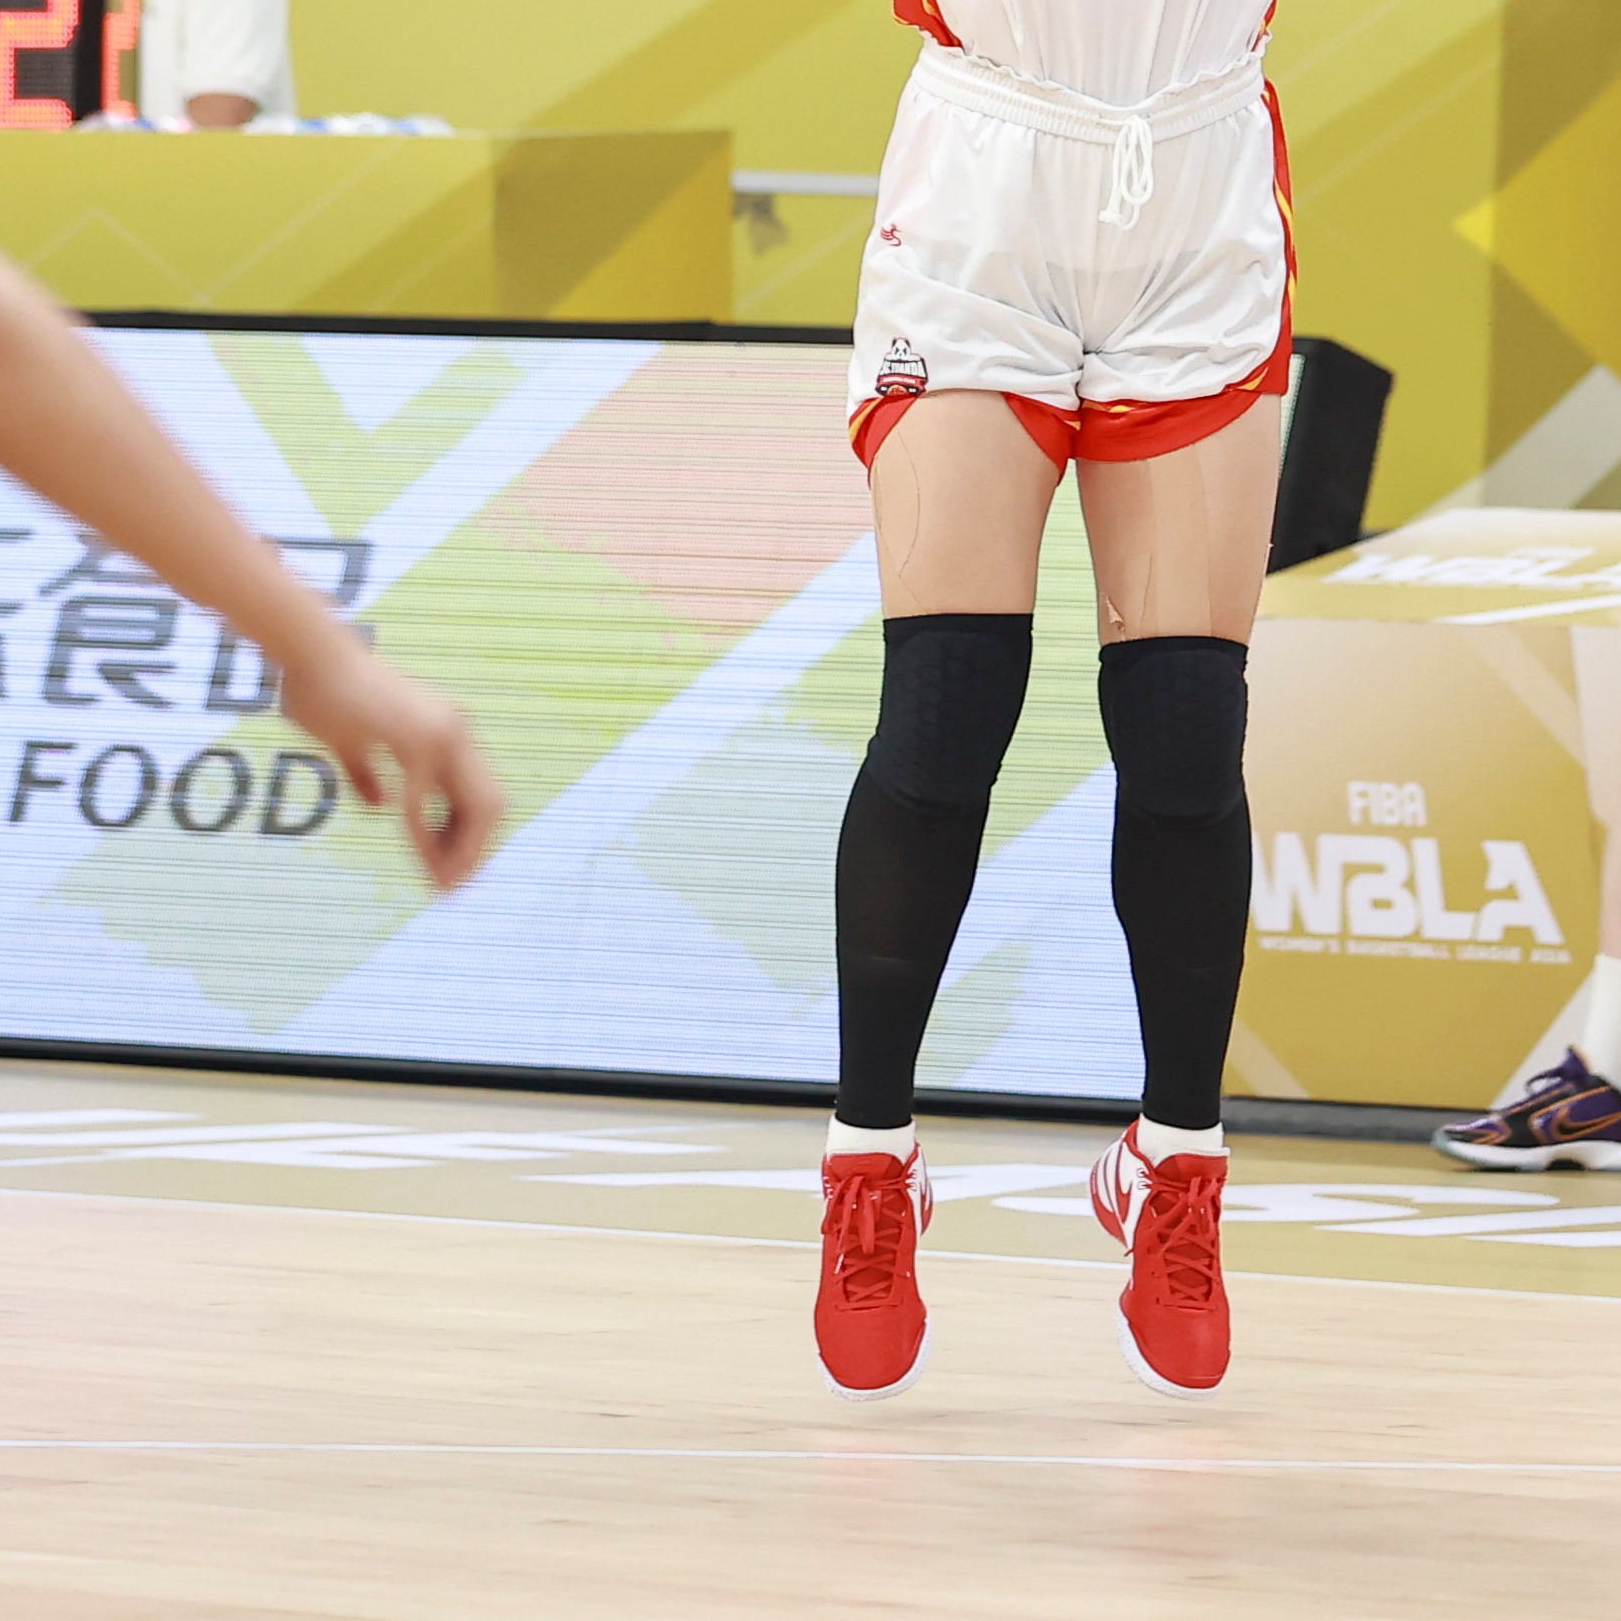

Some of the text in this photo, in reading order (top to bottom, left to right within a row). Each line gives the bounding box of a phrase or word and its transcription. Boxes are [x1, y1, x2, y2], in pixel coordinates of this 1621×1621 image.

[10, 741, 337, 836] FOOD
[1347, 780, 1427, 827] FIBA
[1250, 831, 1565, 945] WBLA
